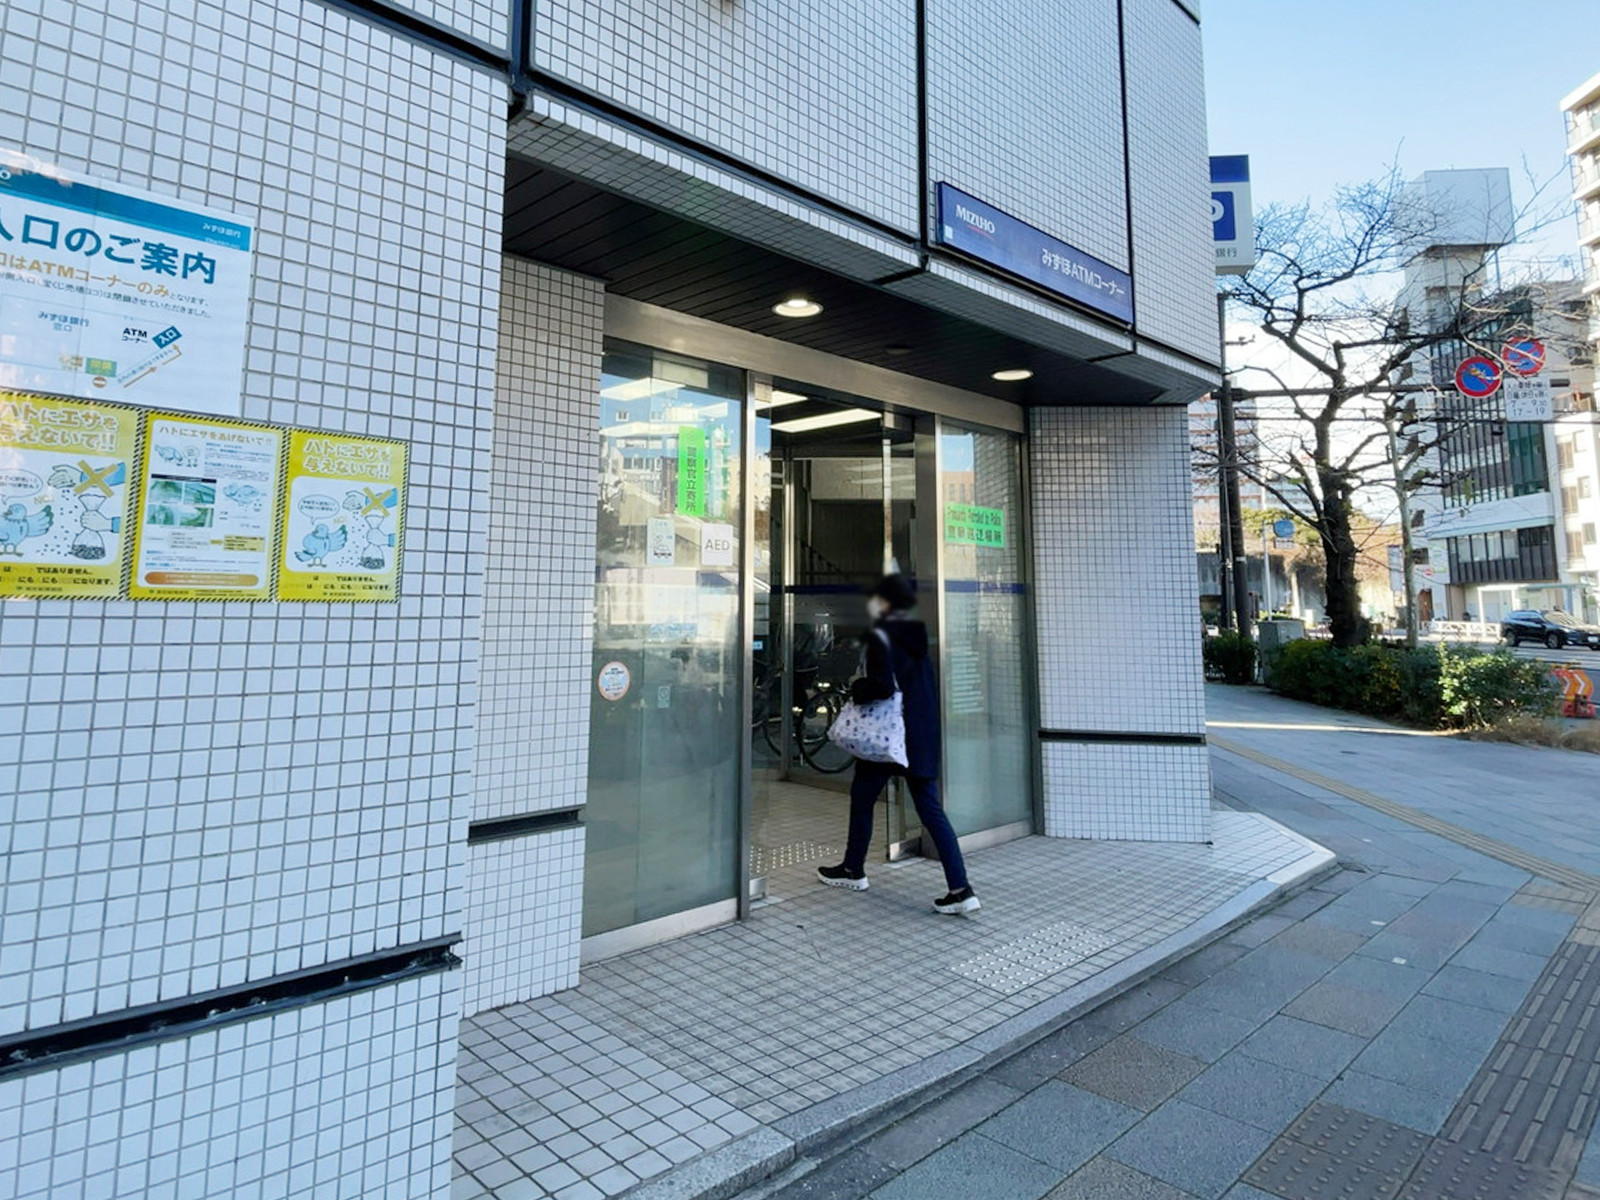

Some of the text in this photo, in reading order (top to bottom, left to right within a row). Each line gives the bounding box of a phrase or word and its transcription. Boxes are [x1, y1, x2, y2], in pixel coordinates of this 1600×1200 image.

[955, 204, 996, 234] MIZUHO
[1041, 248, 1125, 295] みずほATMコーナー
[123, 327, 147, 338] ATM
[158, 329, 177, 345] 入口
[704, 539, 730, 551] AED
